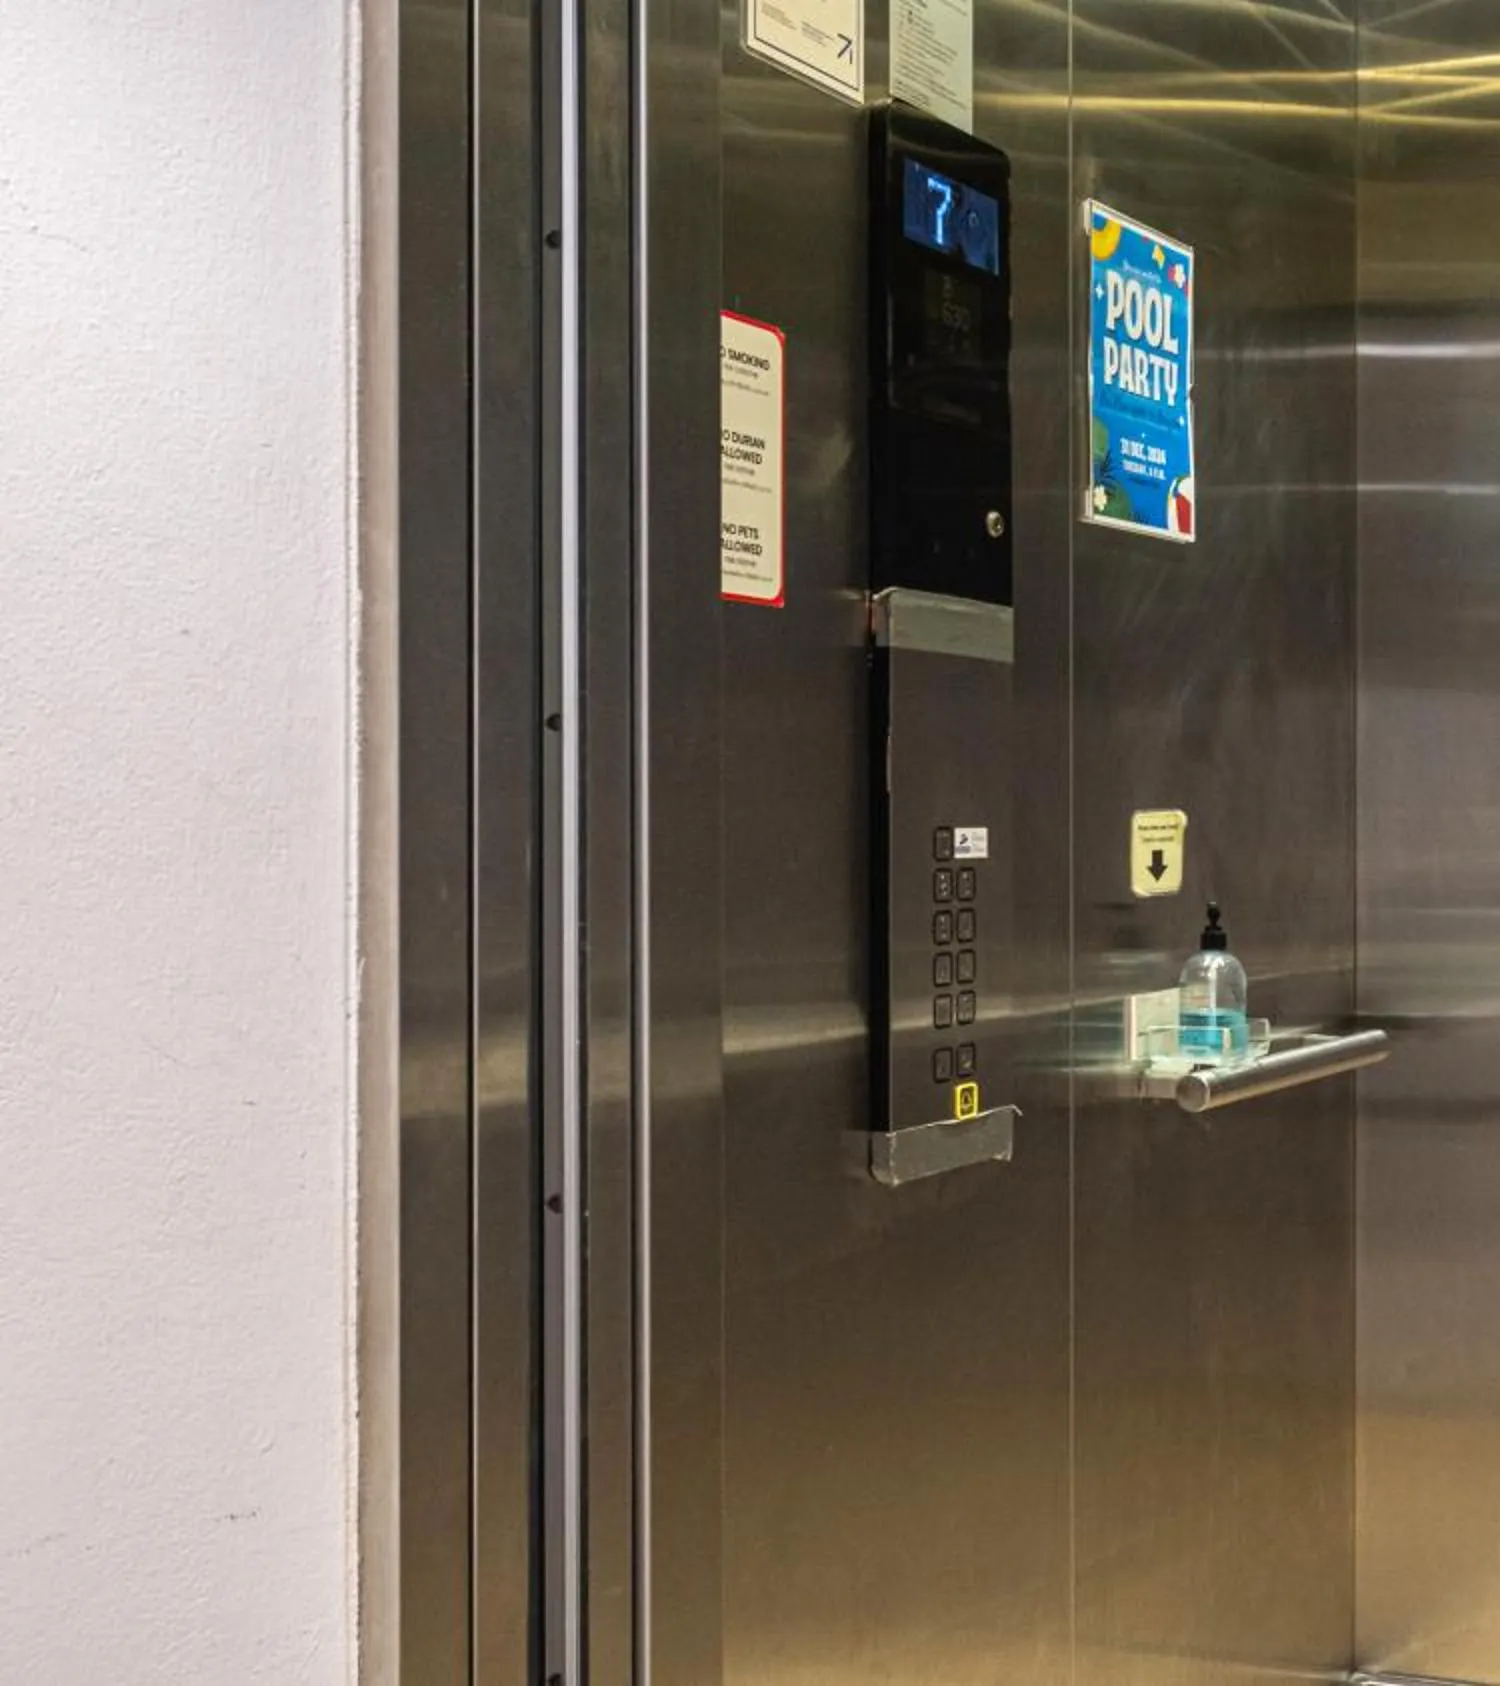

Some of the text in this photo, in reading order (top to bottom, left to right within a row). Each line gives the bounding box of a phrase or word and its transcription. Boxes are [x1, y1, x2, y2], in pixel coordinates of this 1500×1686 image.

[928, 177, 952, 245] 7
[1106, 269, 1178, 354] POOL
[728, 348, 770, 371] SMOKING
[1104, 336, 1178, 406] PARTY
[731, 432, 765, 450] DURIAN
[738, 525, 760, 540] PETS
